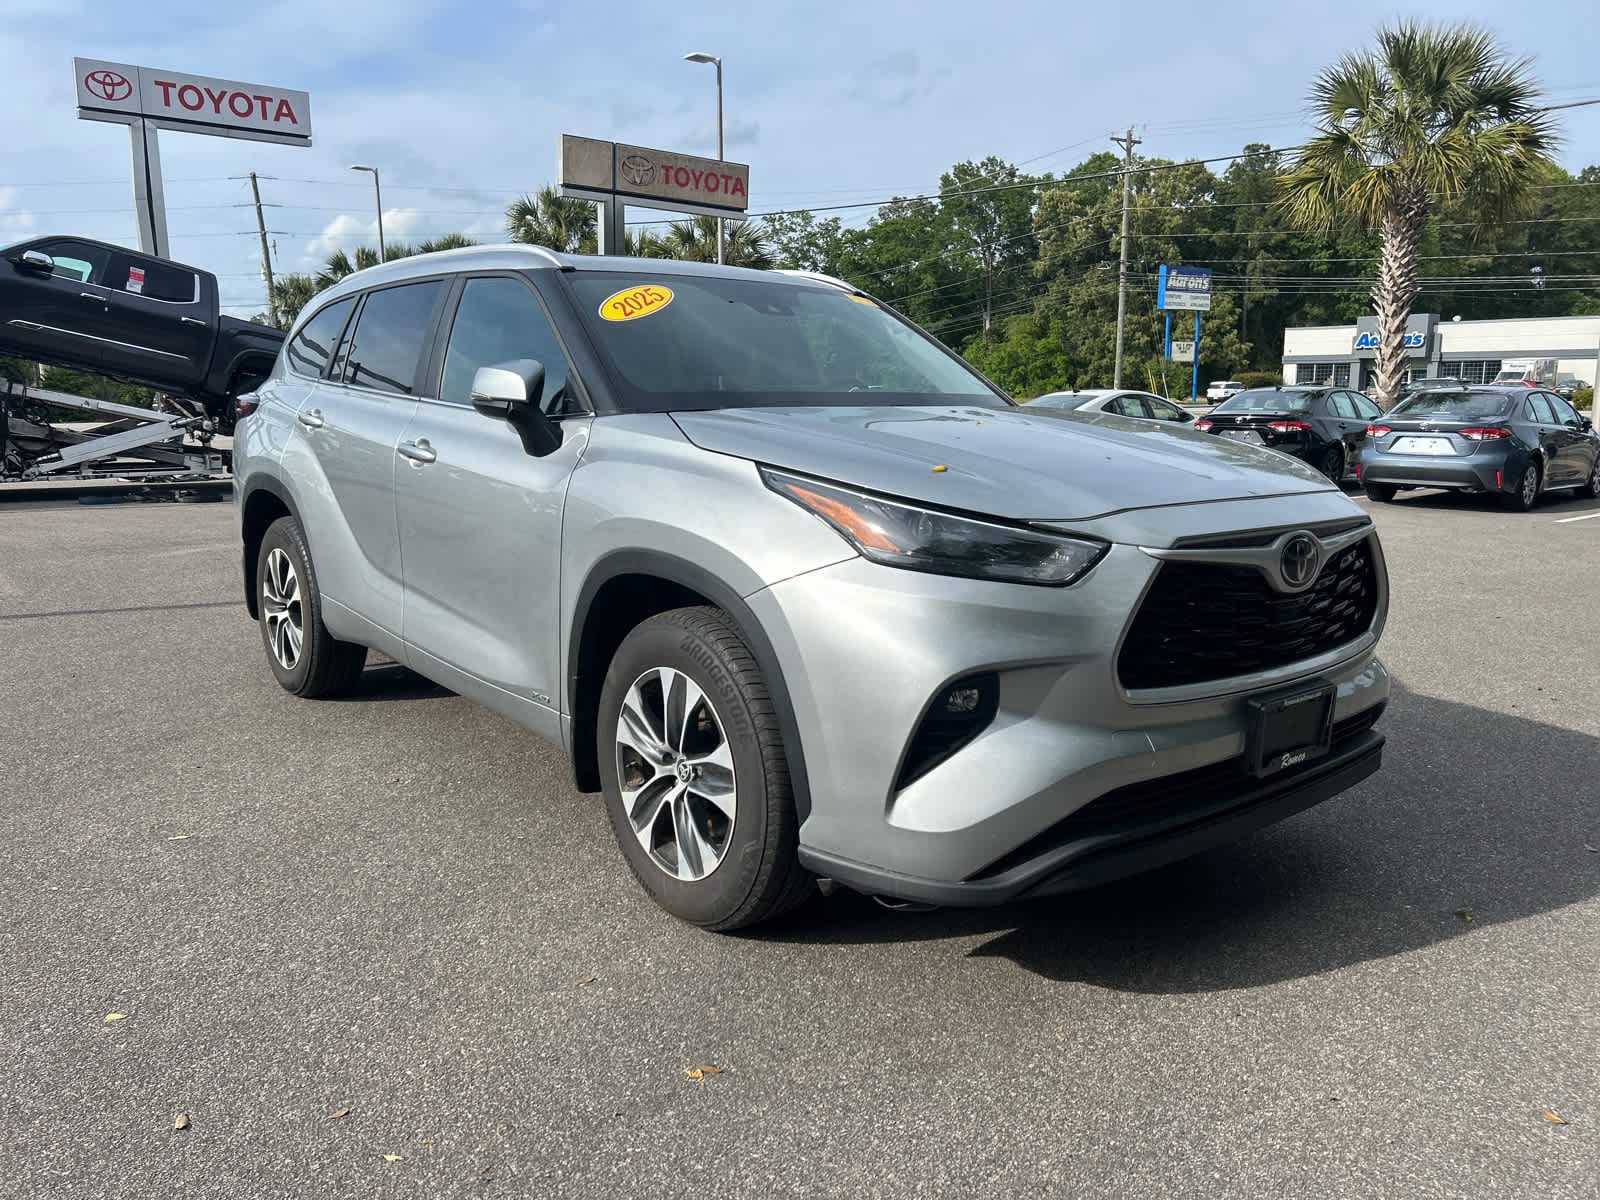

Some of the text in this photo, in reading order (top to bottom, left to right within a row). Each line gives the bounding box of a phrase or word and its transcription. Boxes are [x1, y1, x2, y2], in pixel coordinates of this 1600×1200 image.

[154, 80, 298, 124] TOYOTA
[661, 164, 746, 197] TOYOTA
[613, 286, 665, 318] 2025
[1355, 331, 1425, 349] Aan's
[680, 634, 754, 743] BRIDGESTONE
